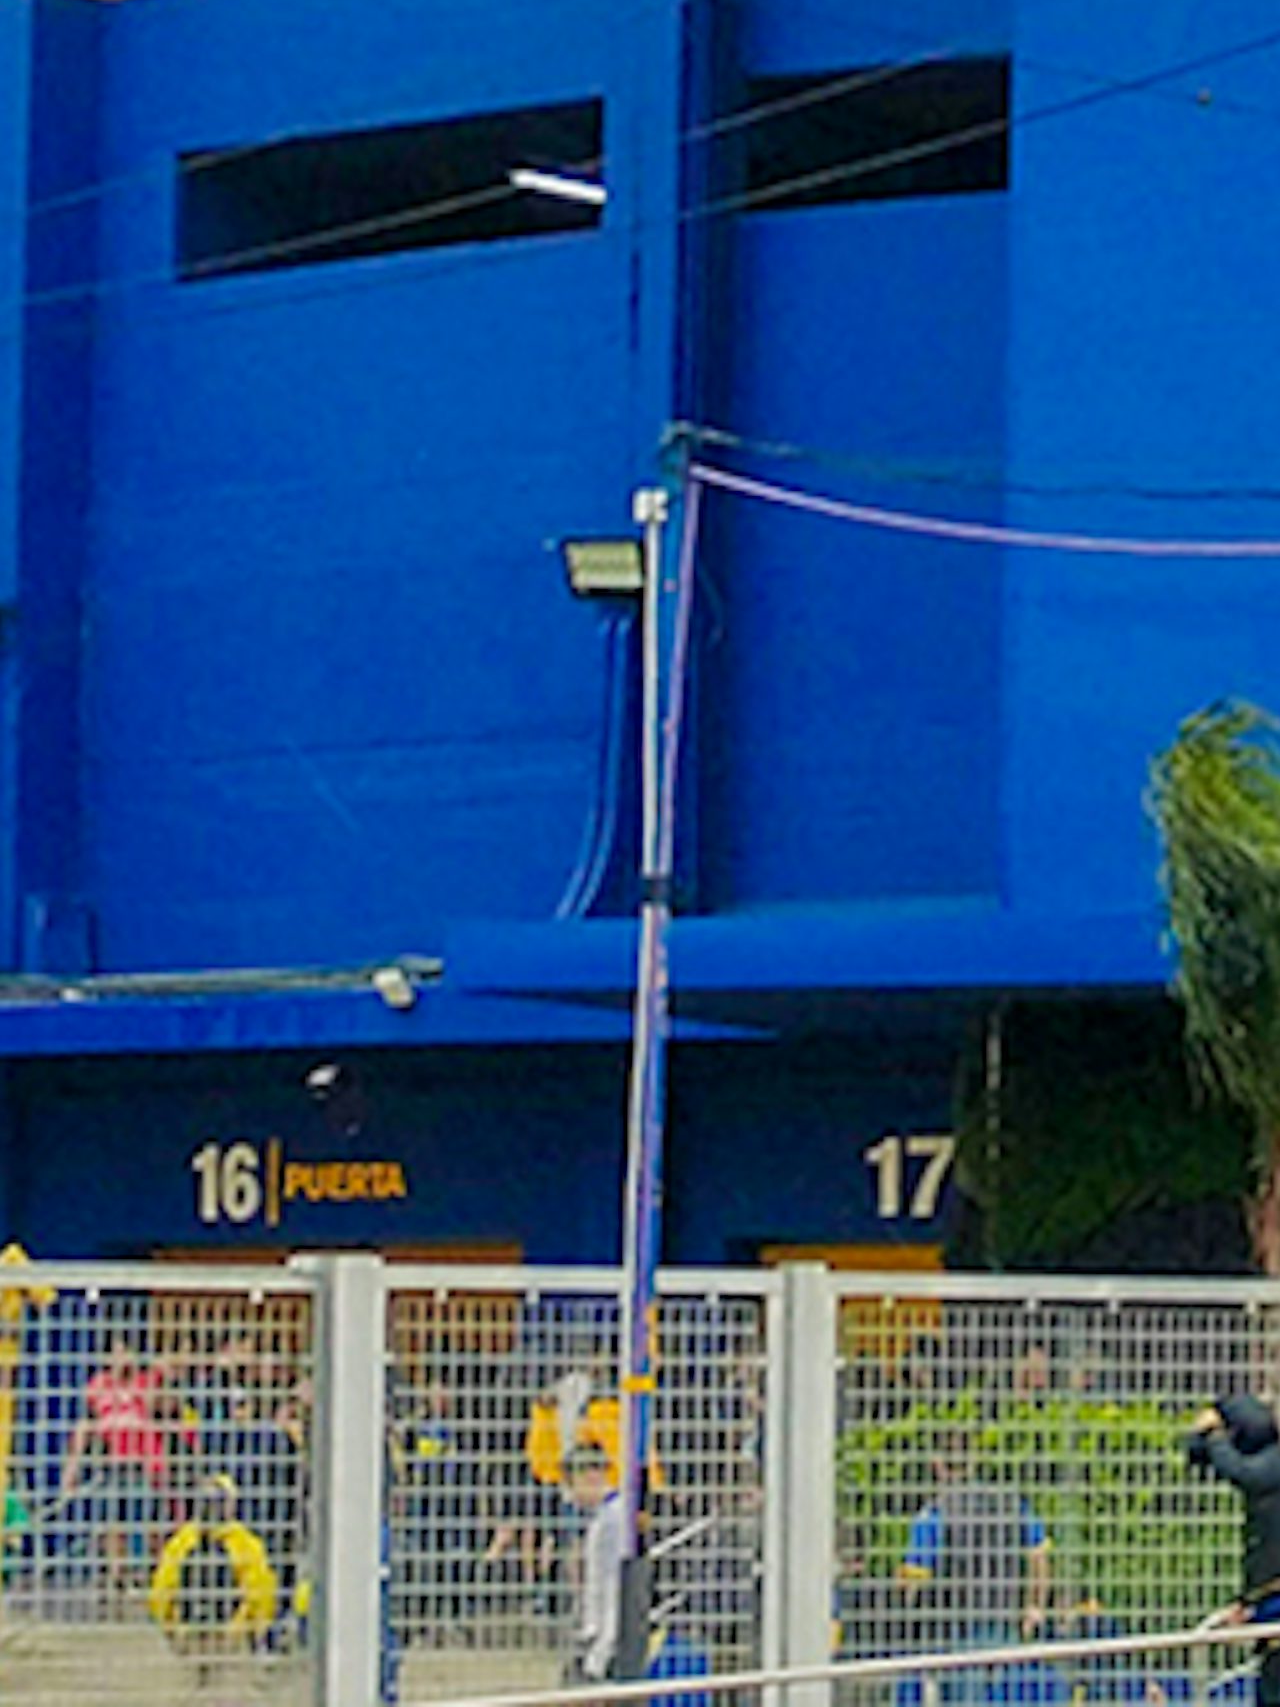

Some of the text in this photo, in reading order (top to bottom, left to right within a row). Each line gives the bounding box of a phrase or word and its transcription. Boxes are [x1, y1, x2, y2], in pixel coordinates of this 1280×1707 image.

[191, 1140, 408, 1224] 16 PUERTA
[865, 1136, 955, 1220] 17
